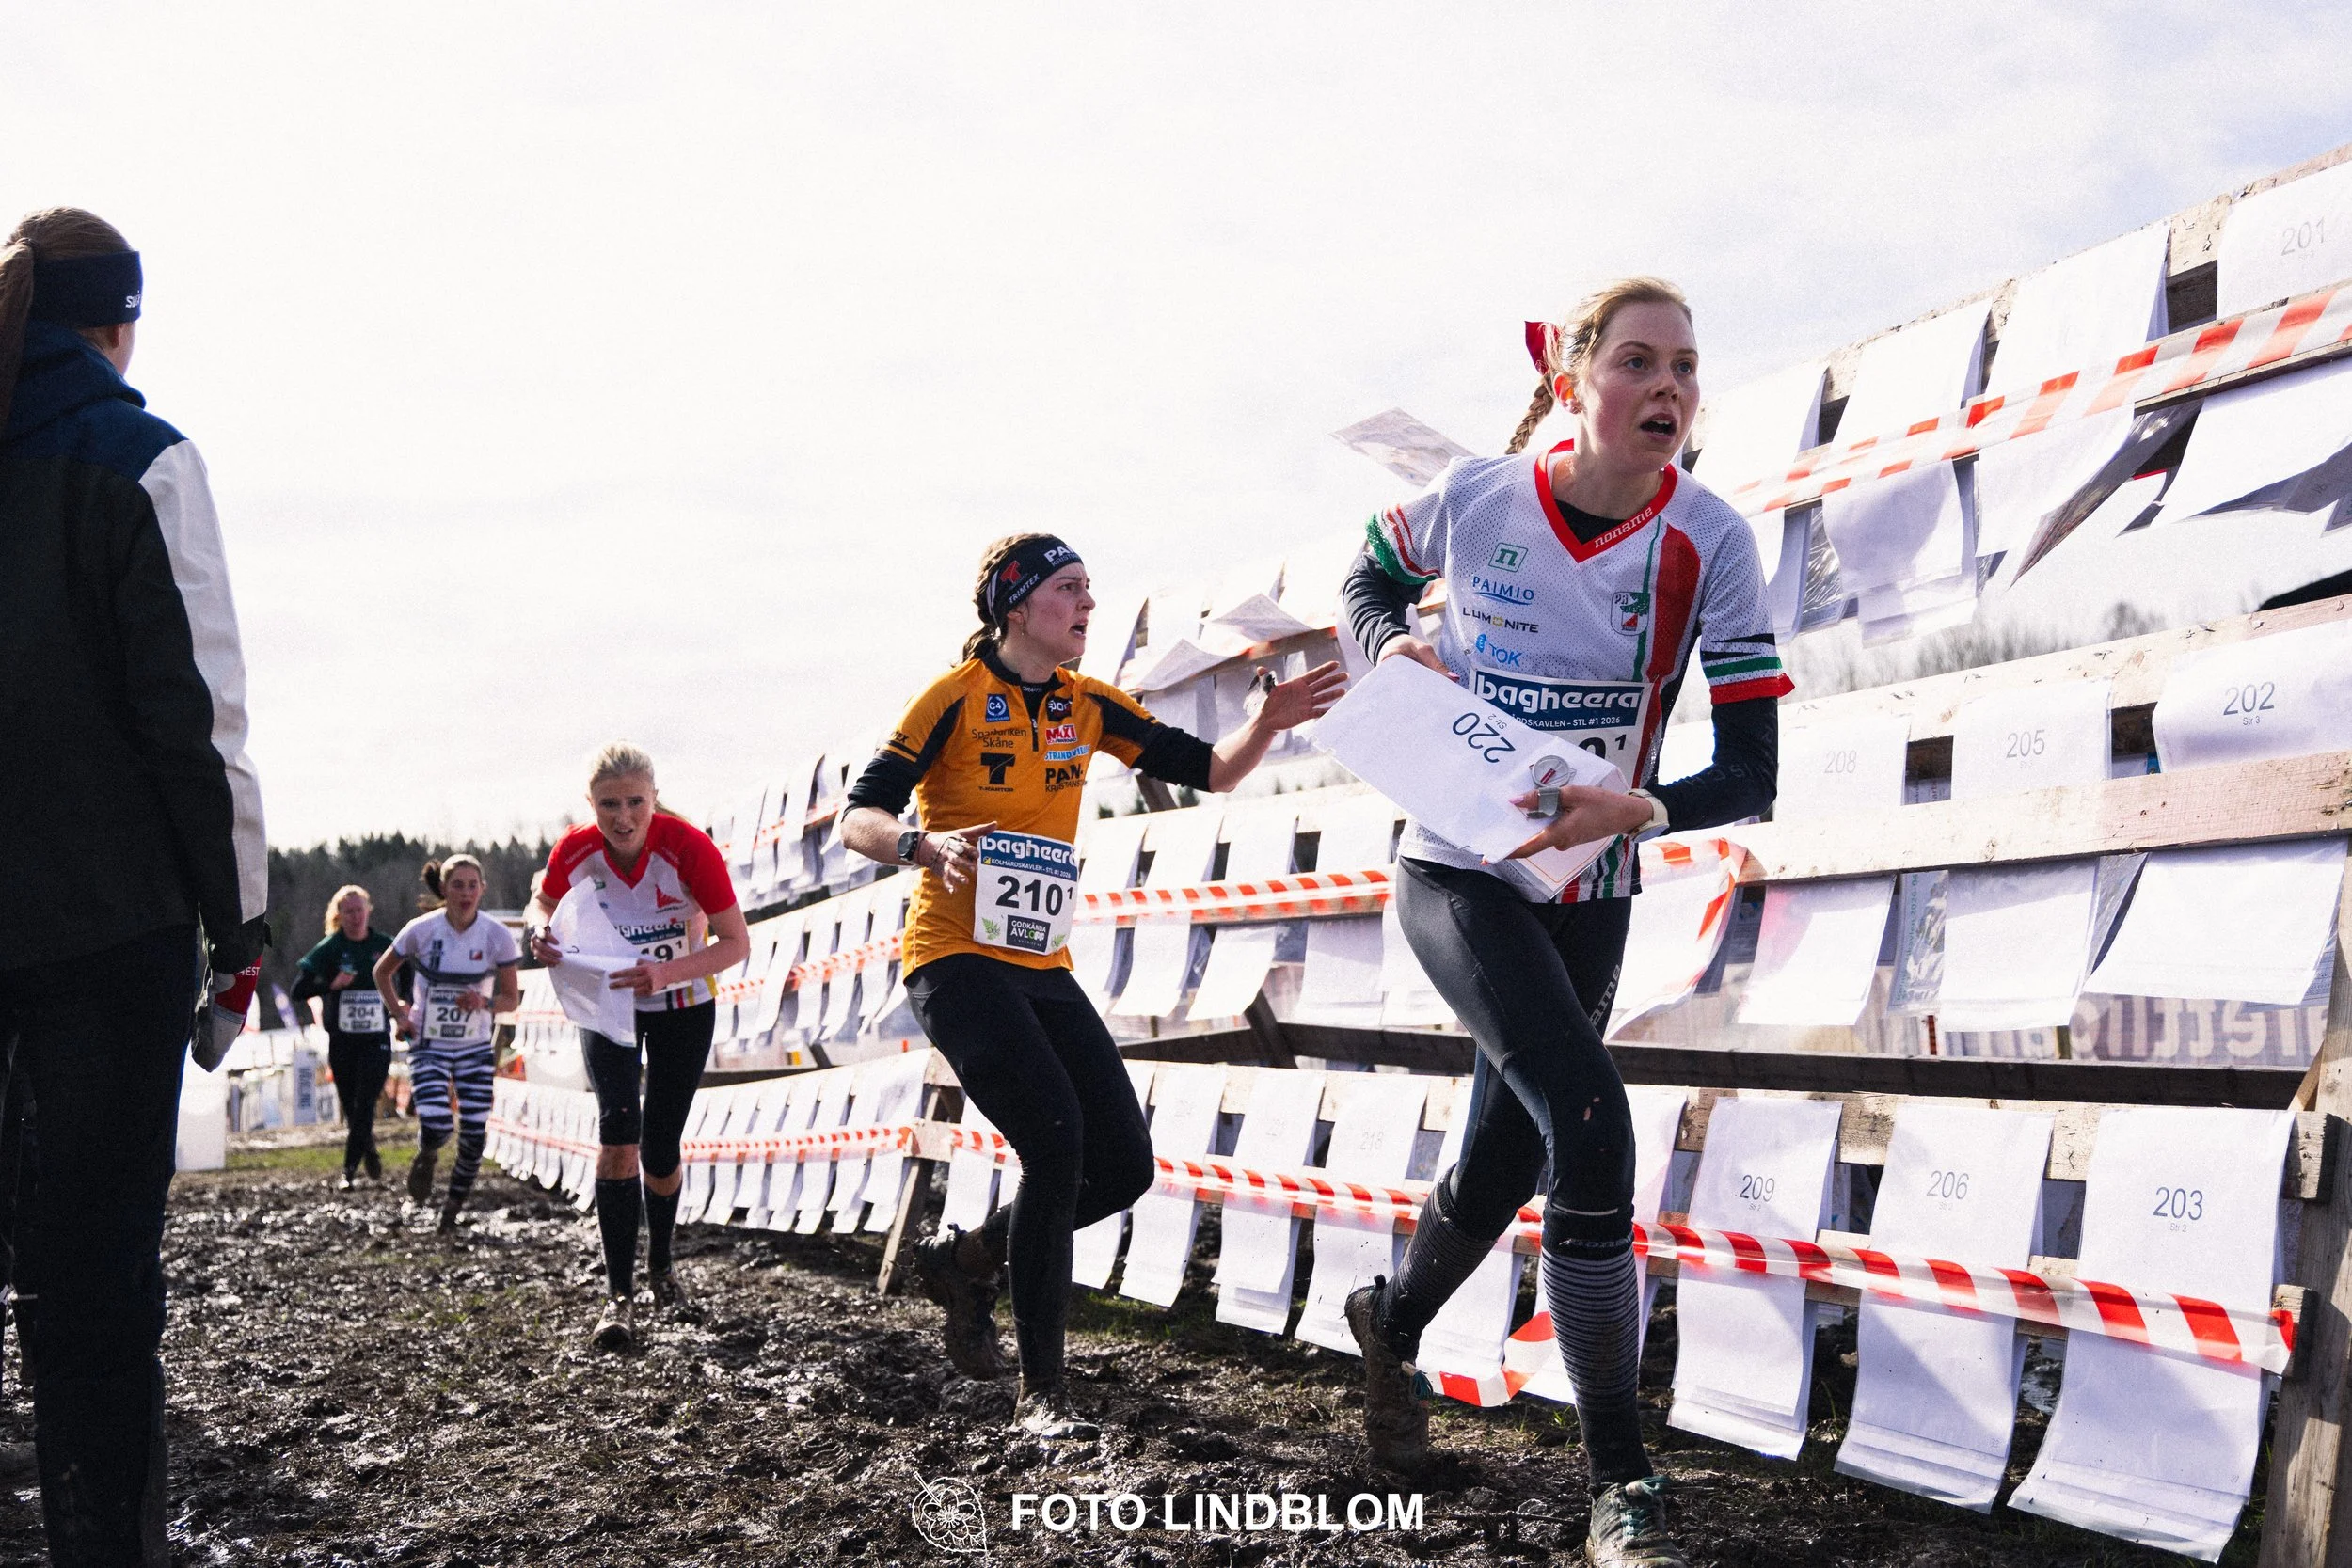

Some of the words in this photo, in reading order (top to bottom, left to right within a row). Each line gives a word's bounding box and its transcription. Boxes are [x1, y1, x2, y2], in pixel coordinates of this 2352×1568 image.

[2281, 216, 2325, 256] 201
[1595, 507, 1653, 548] noname
[1008, 573, 1040, 603] TRIMTEX
[1472, 576, 1534, 600] PAIMIO
[1462, 607, 1539, 633] LUMONITE
[989, 702, 1002, 710] C4
[1477, 674, 1642, 714] bagheera
[2223, 681, 2275, 716] 202
[2242, 717, 2253, 726] Str
[2255, 715, 2261, 724] 3
[982, 736, 1014, 749] Skåne
[1453, 712, 1516, 764] 220
[2006, 729, 2045, 759] 205
[1824, 750, 1857, 774] 208
[991, 858, 1042, 872] KOLMÅRDSKAVLEN
[995, 875, 1063, 916] 210
[347, 1006, 375, 1018] 204
[1740, 1174, 1775, 1203] 209
[1926, 1170, 1970, 1200] 206
[2153, 1186, 2203, 1221] 203
